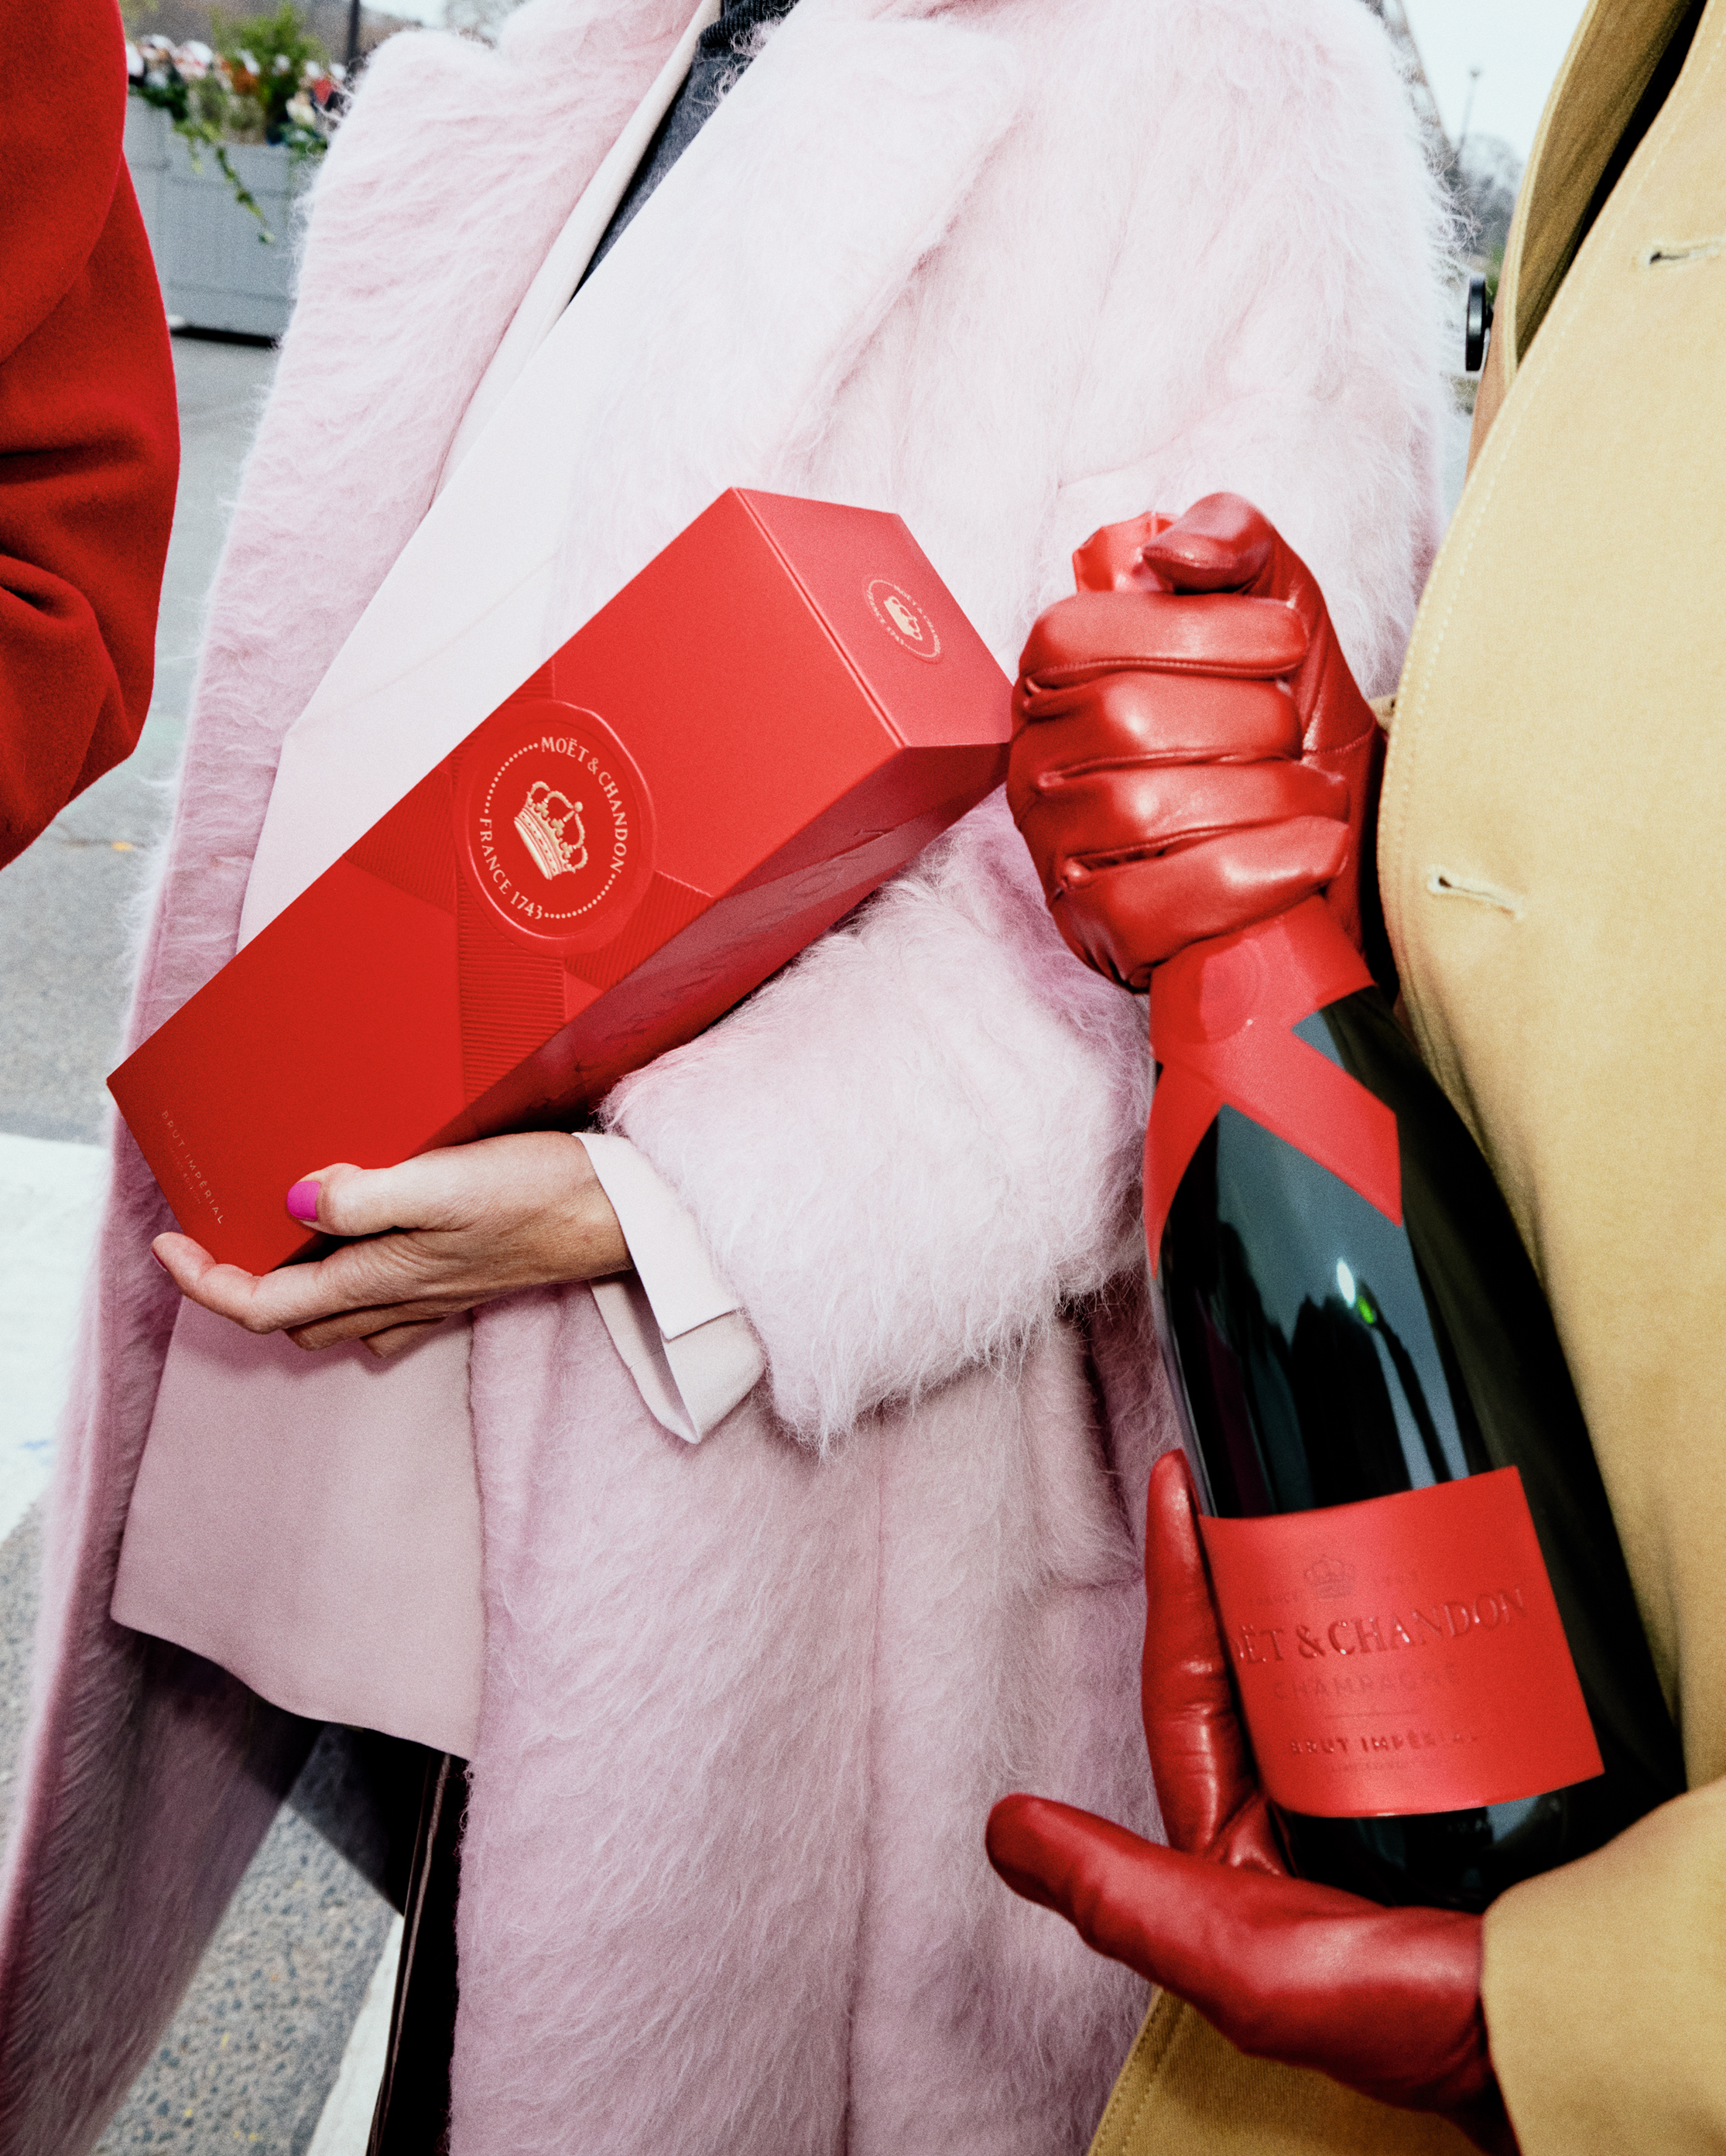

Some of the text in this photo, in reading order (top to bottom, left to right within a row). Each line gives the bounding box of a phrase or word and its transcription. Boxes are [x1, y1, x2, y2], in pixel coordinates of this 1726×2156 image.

[541, 737, 628, 873] MOËT & CHANDON
[479, 817, 543, 920] FRANCE 1743
[162, 1111, 224, 1223] BRUT IMPÉRIAL
[1296, 1624, 1325, 1658] &
[1328, 1588, 1528, 1655] CHANDON
